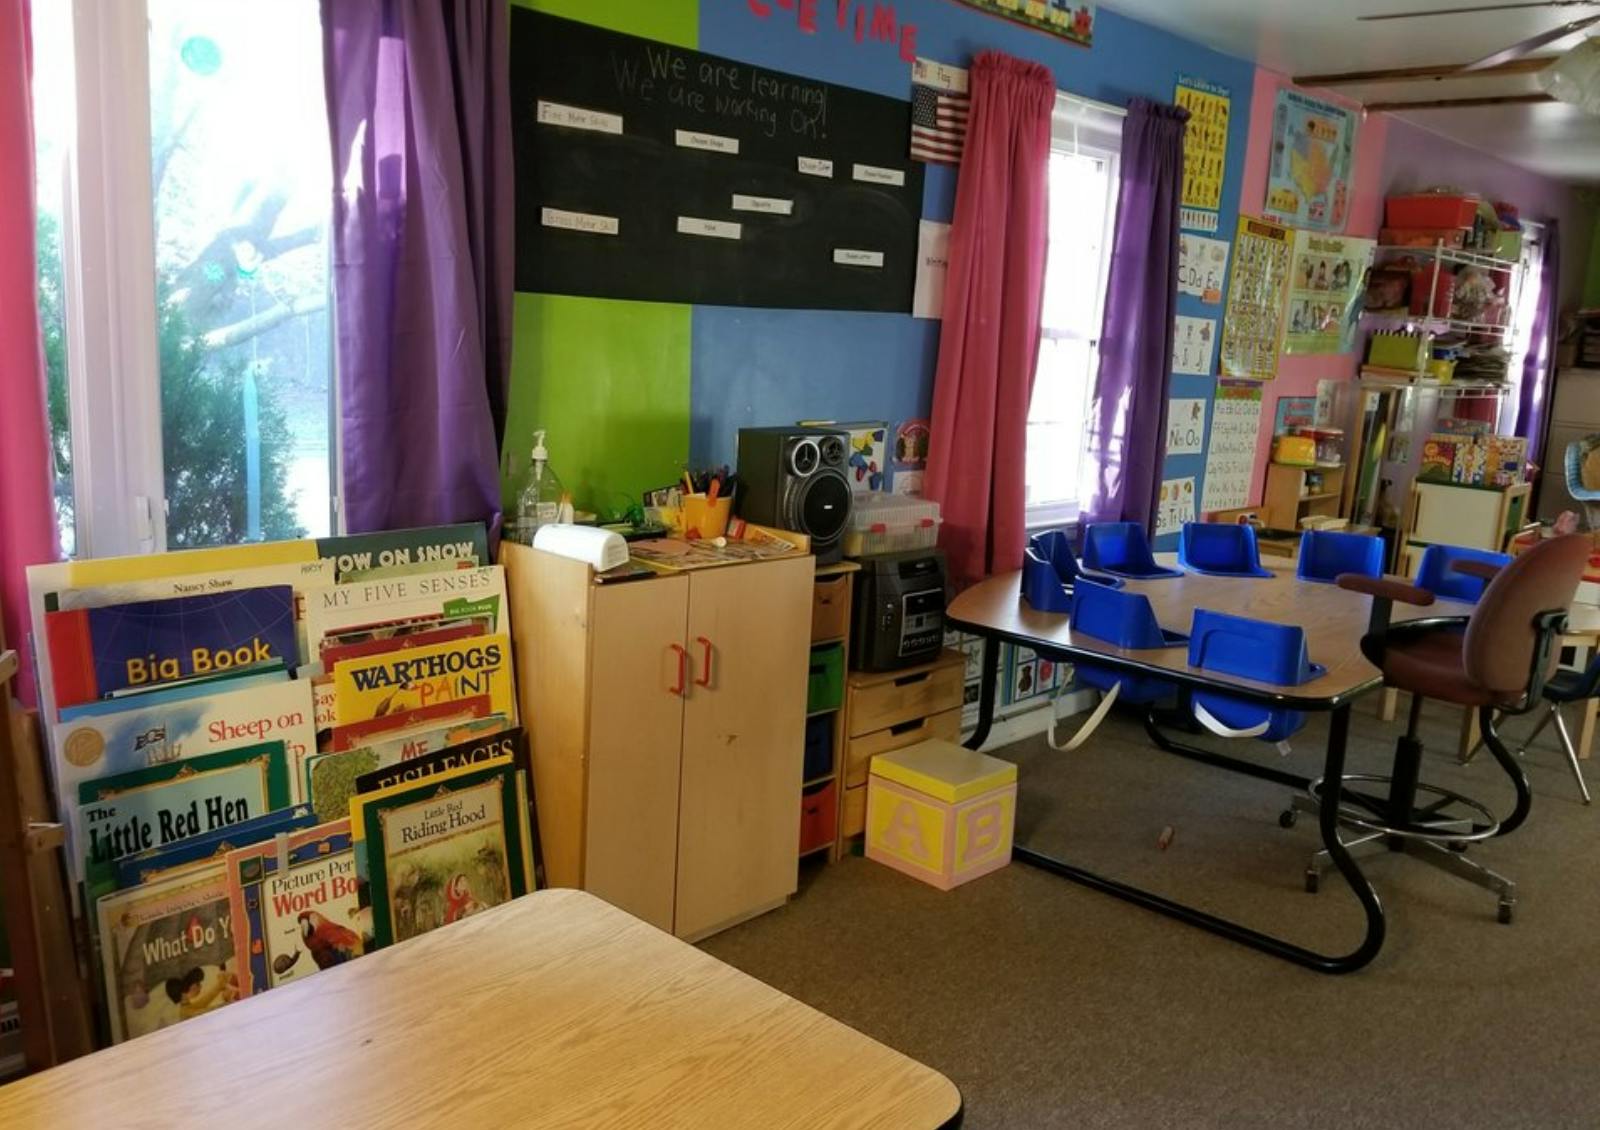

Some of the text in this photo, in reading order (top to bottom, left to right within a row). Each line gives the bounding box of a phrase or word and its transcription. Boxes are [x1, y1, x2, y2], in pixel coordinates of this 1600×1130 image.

[646, 46, 687, 80] We
[699, 62, 741, 90] are
[379, 547, 411, 567] ON
[417, 541, 474, 563] SNOW
[173, 578, 234, 594] Nancy Shaw
[323, 572, 491, 608] MY FIVE SENSES
[126, 637, 272, 685] Big Book
[350, 643, 502, 692] WARTHOGS
[418, 668, 500, 706] PAINT
[208, 711, 304, 743] Sheep on
[400, 740, 428, 761] ME
[86, 806, 116, 823] The
[401, 804, 487, 844] Riding Hood
[423, 800, 464, 820] Little Red
[89, 795, 249, 866] Little Red Hen
[880, 801, 930, 860] A
[963, 801, 1005, 863] B
[271, 858, 355, 895] Picture Per
[272, 875, 360, 917] Word Bo
[142, 914, 232, 965] What Do Y
